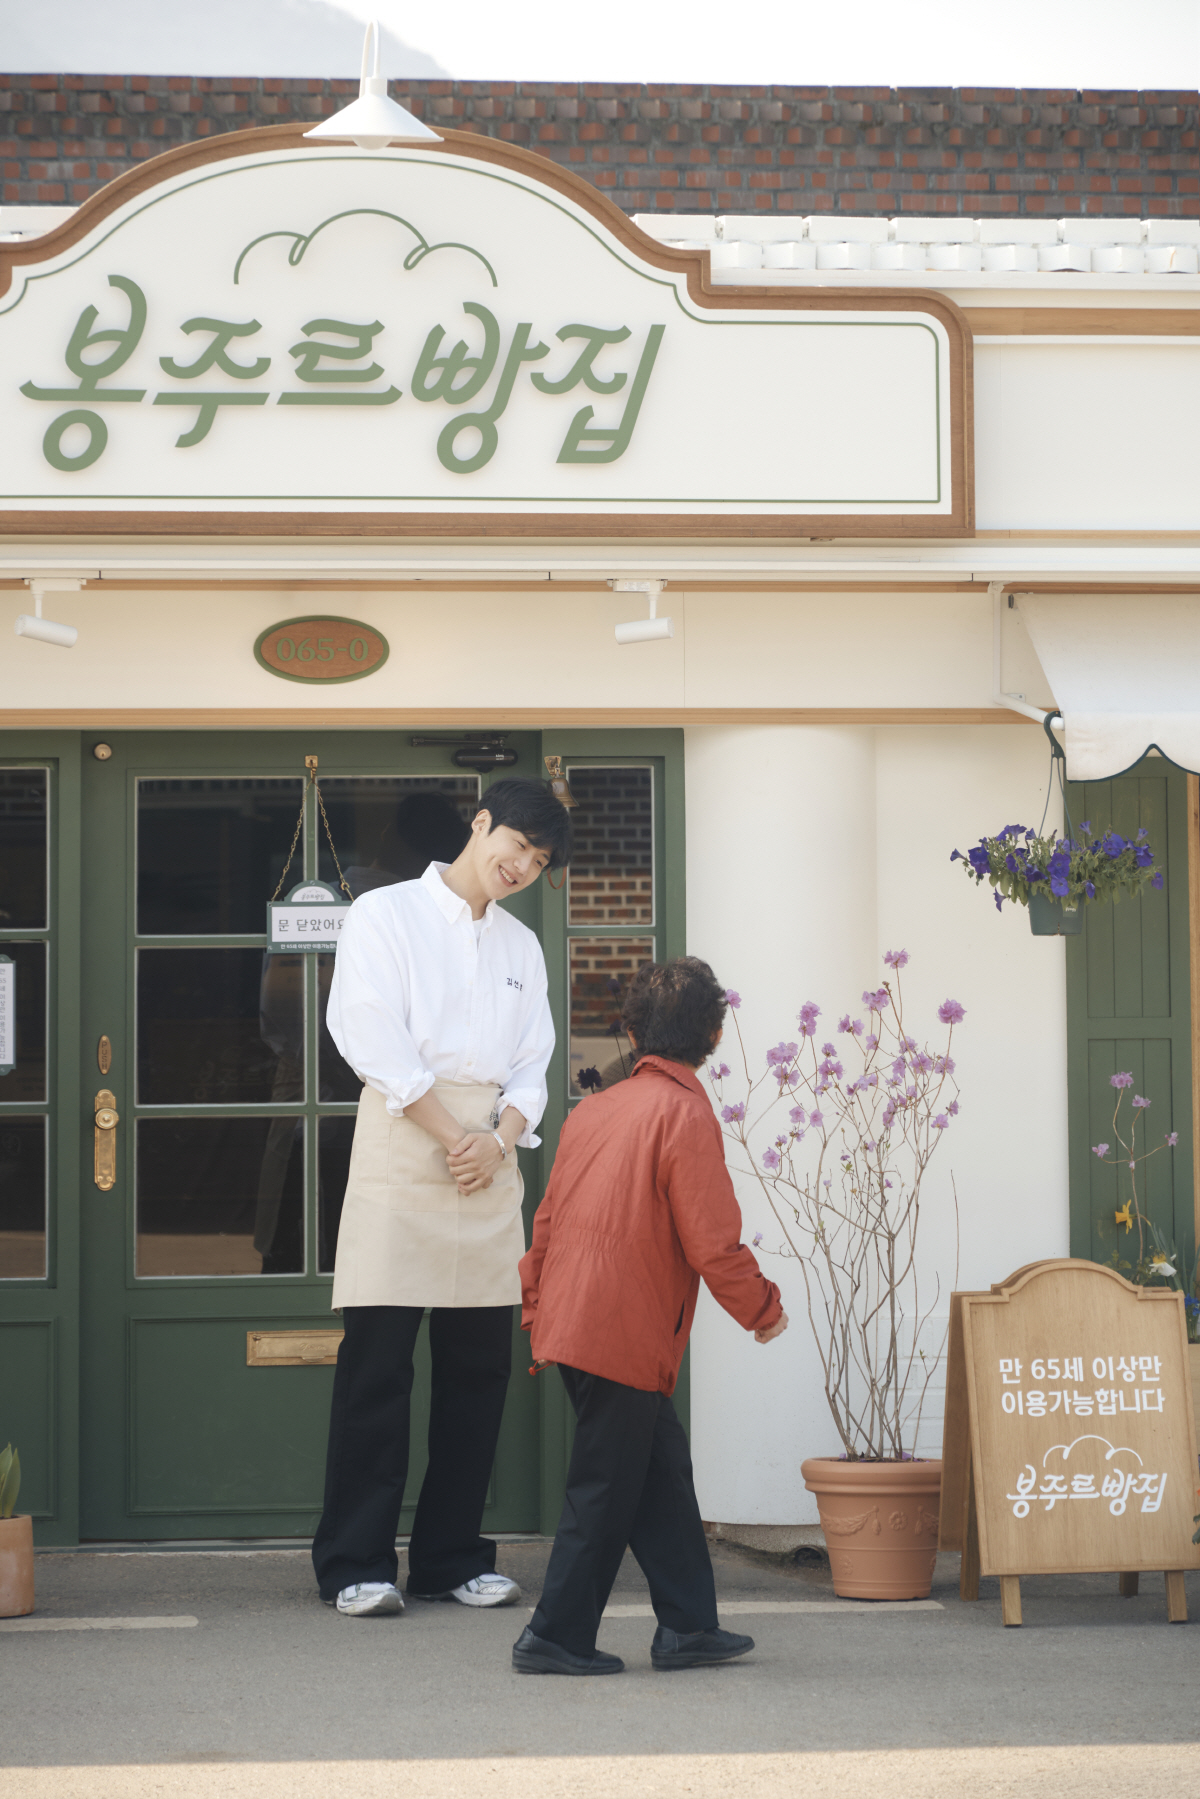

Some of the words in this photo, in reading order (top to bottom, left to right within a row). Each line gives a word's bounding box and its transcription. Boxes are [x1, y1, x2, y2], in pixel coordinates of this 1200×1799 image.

[19, 274, 667, 474] 봉주르빵집
[276, 637, 369, 662] 065-0
[278, 919, 290, 932] 문
[999, 1357, 1023, 1385] 만
[1030, 1356, 1085, 1383] 65세
[1092, 1355, 1163, 1383] 이상만
[1001, 1387, 1166, 1418] 이용가능합니다
[1006, 1463, 1168, 1519] 봉주르빵집
